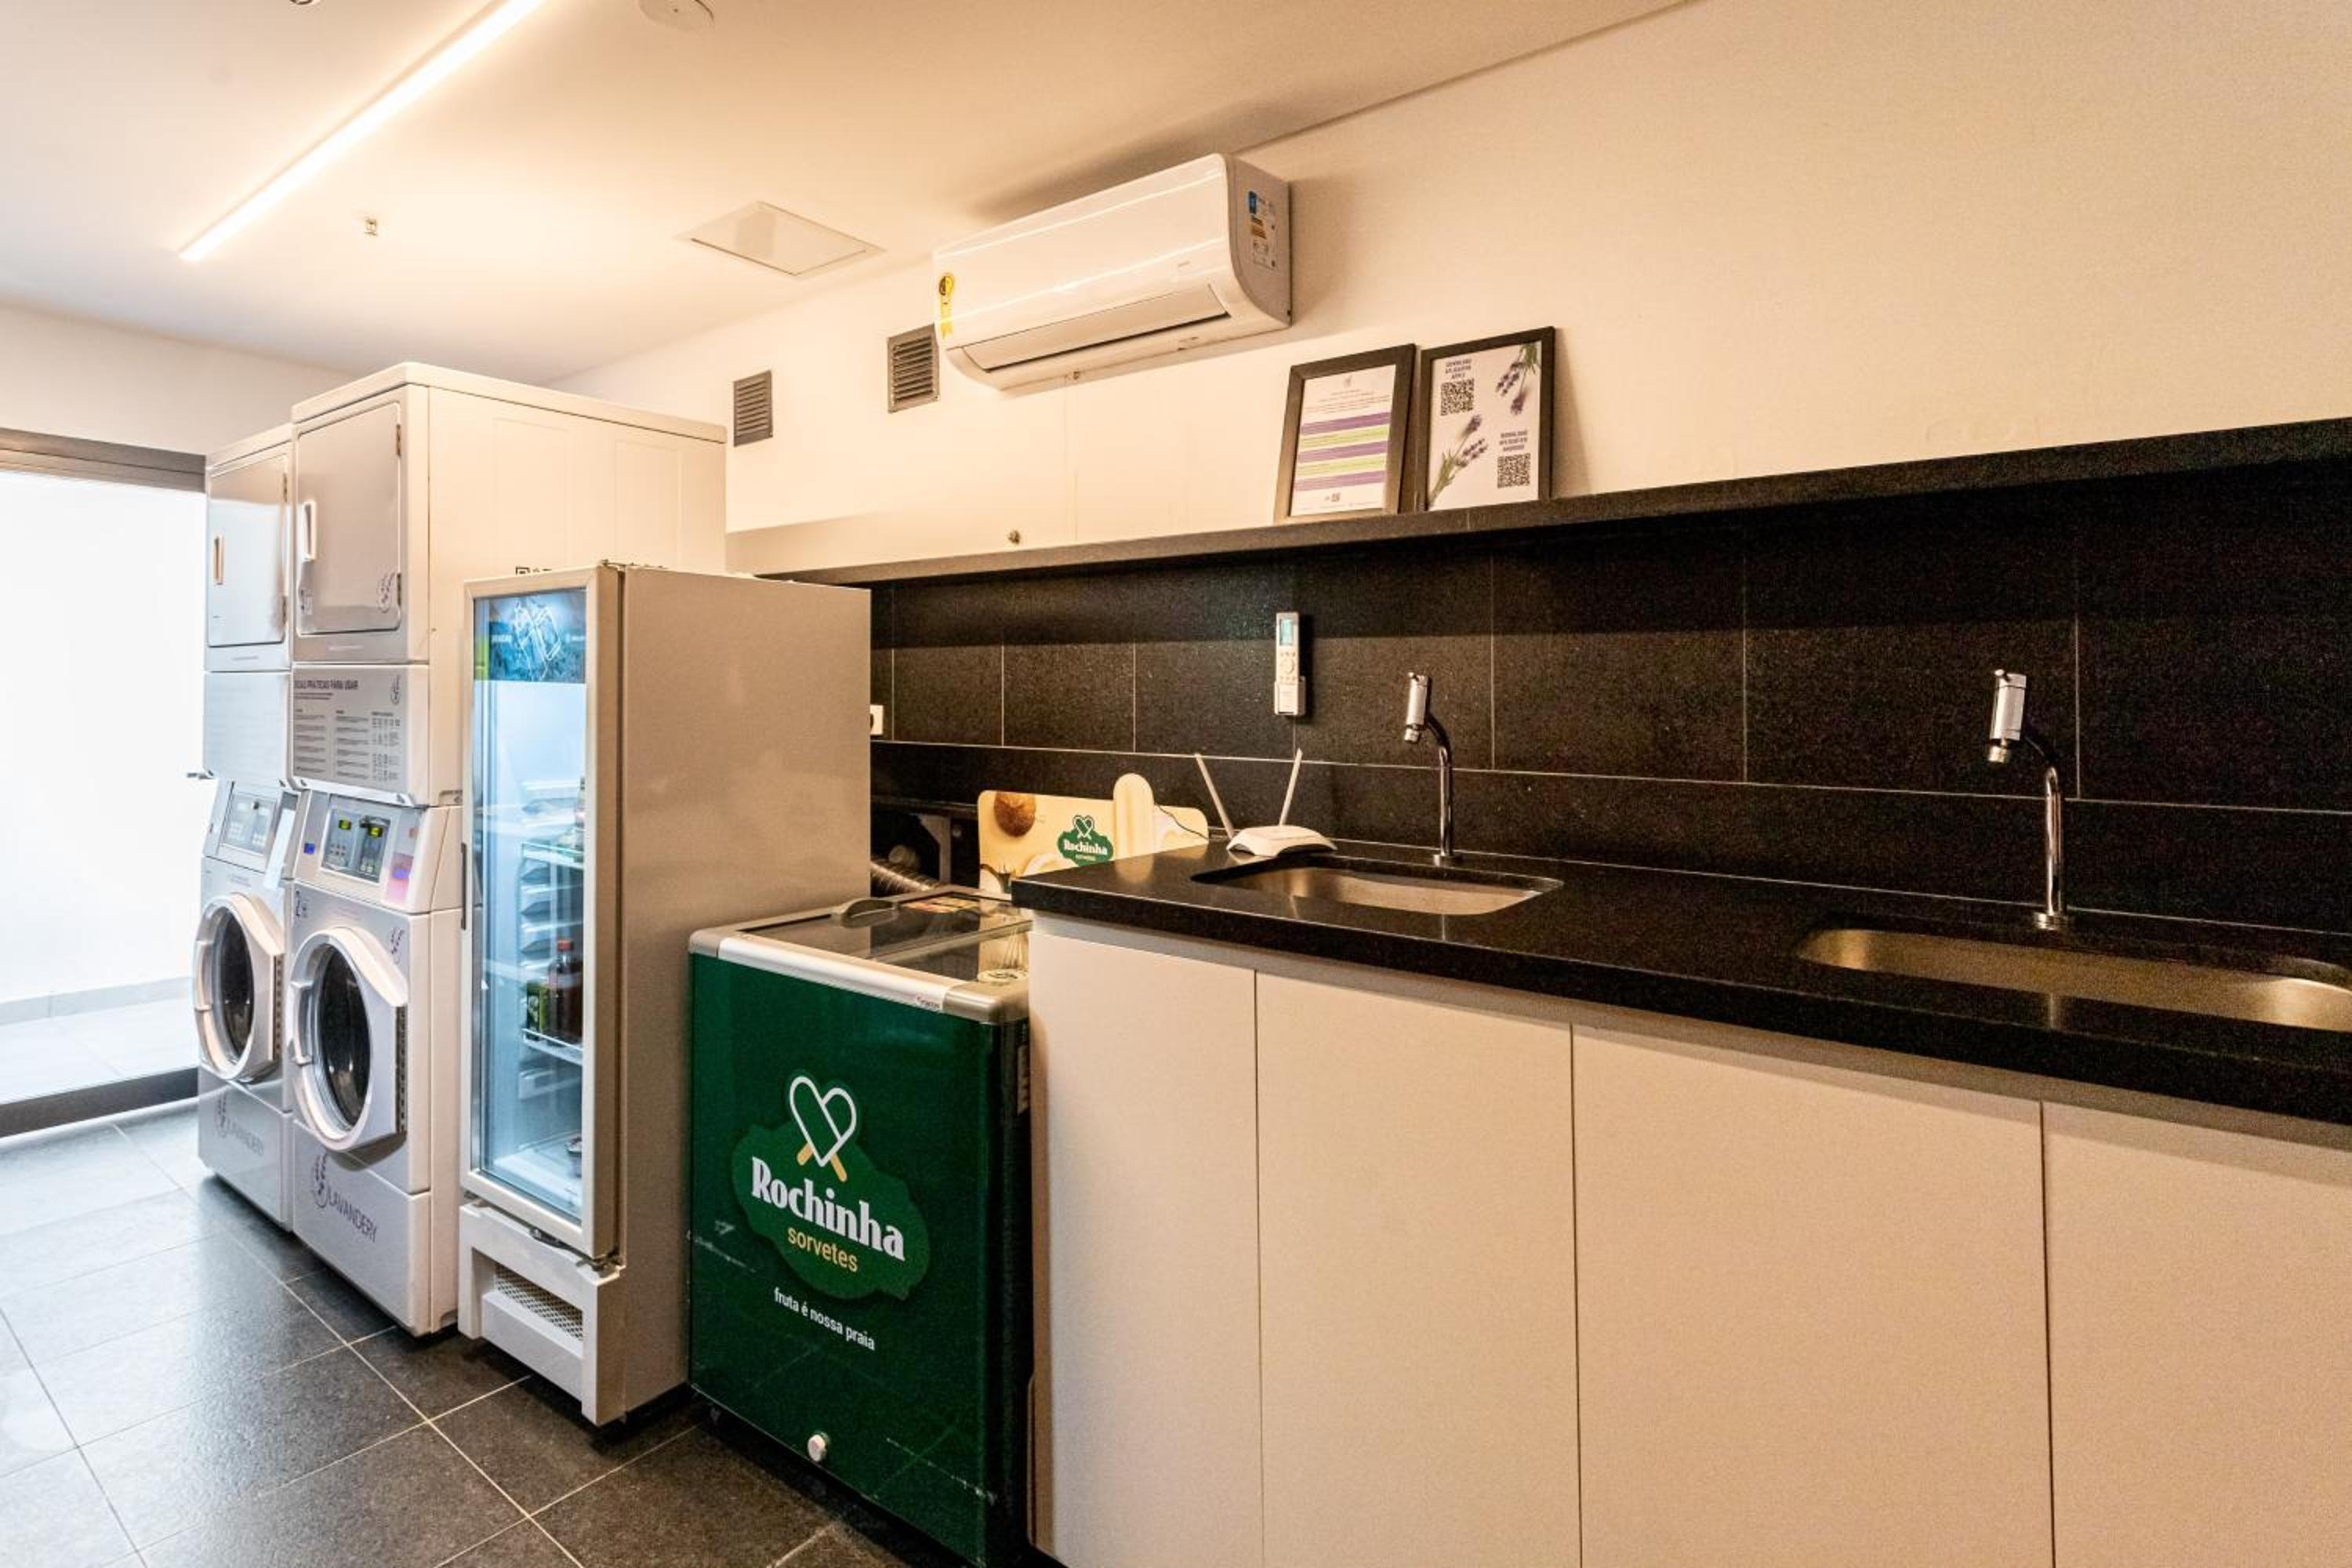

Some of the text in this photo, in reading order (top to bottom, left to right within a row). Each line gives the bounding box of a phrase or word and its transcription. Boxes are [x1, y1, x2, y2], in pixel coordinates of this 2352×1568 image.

[1064, 839, 1108, 855] Rochinha
[328, 1185, 377, 1243] LAVANDERY
[752, 1156, 905, 1261] Rochinha
[787, 1227, 858, 1273] sorvetes
[774, 1287, 876, 1351] fruta é nossa praia
